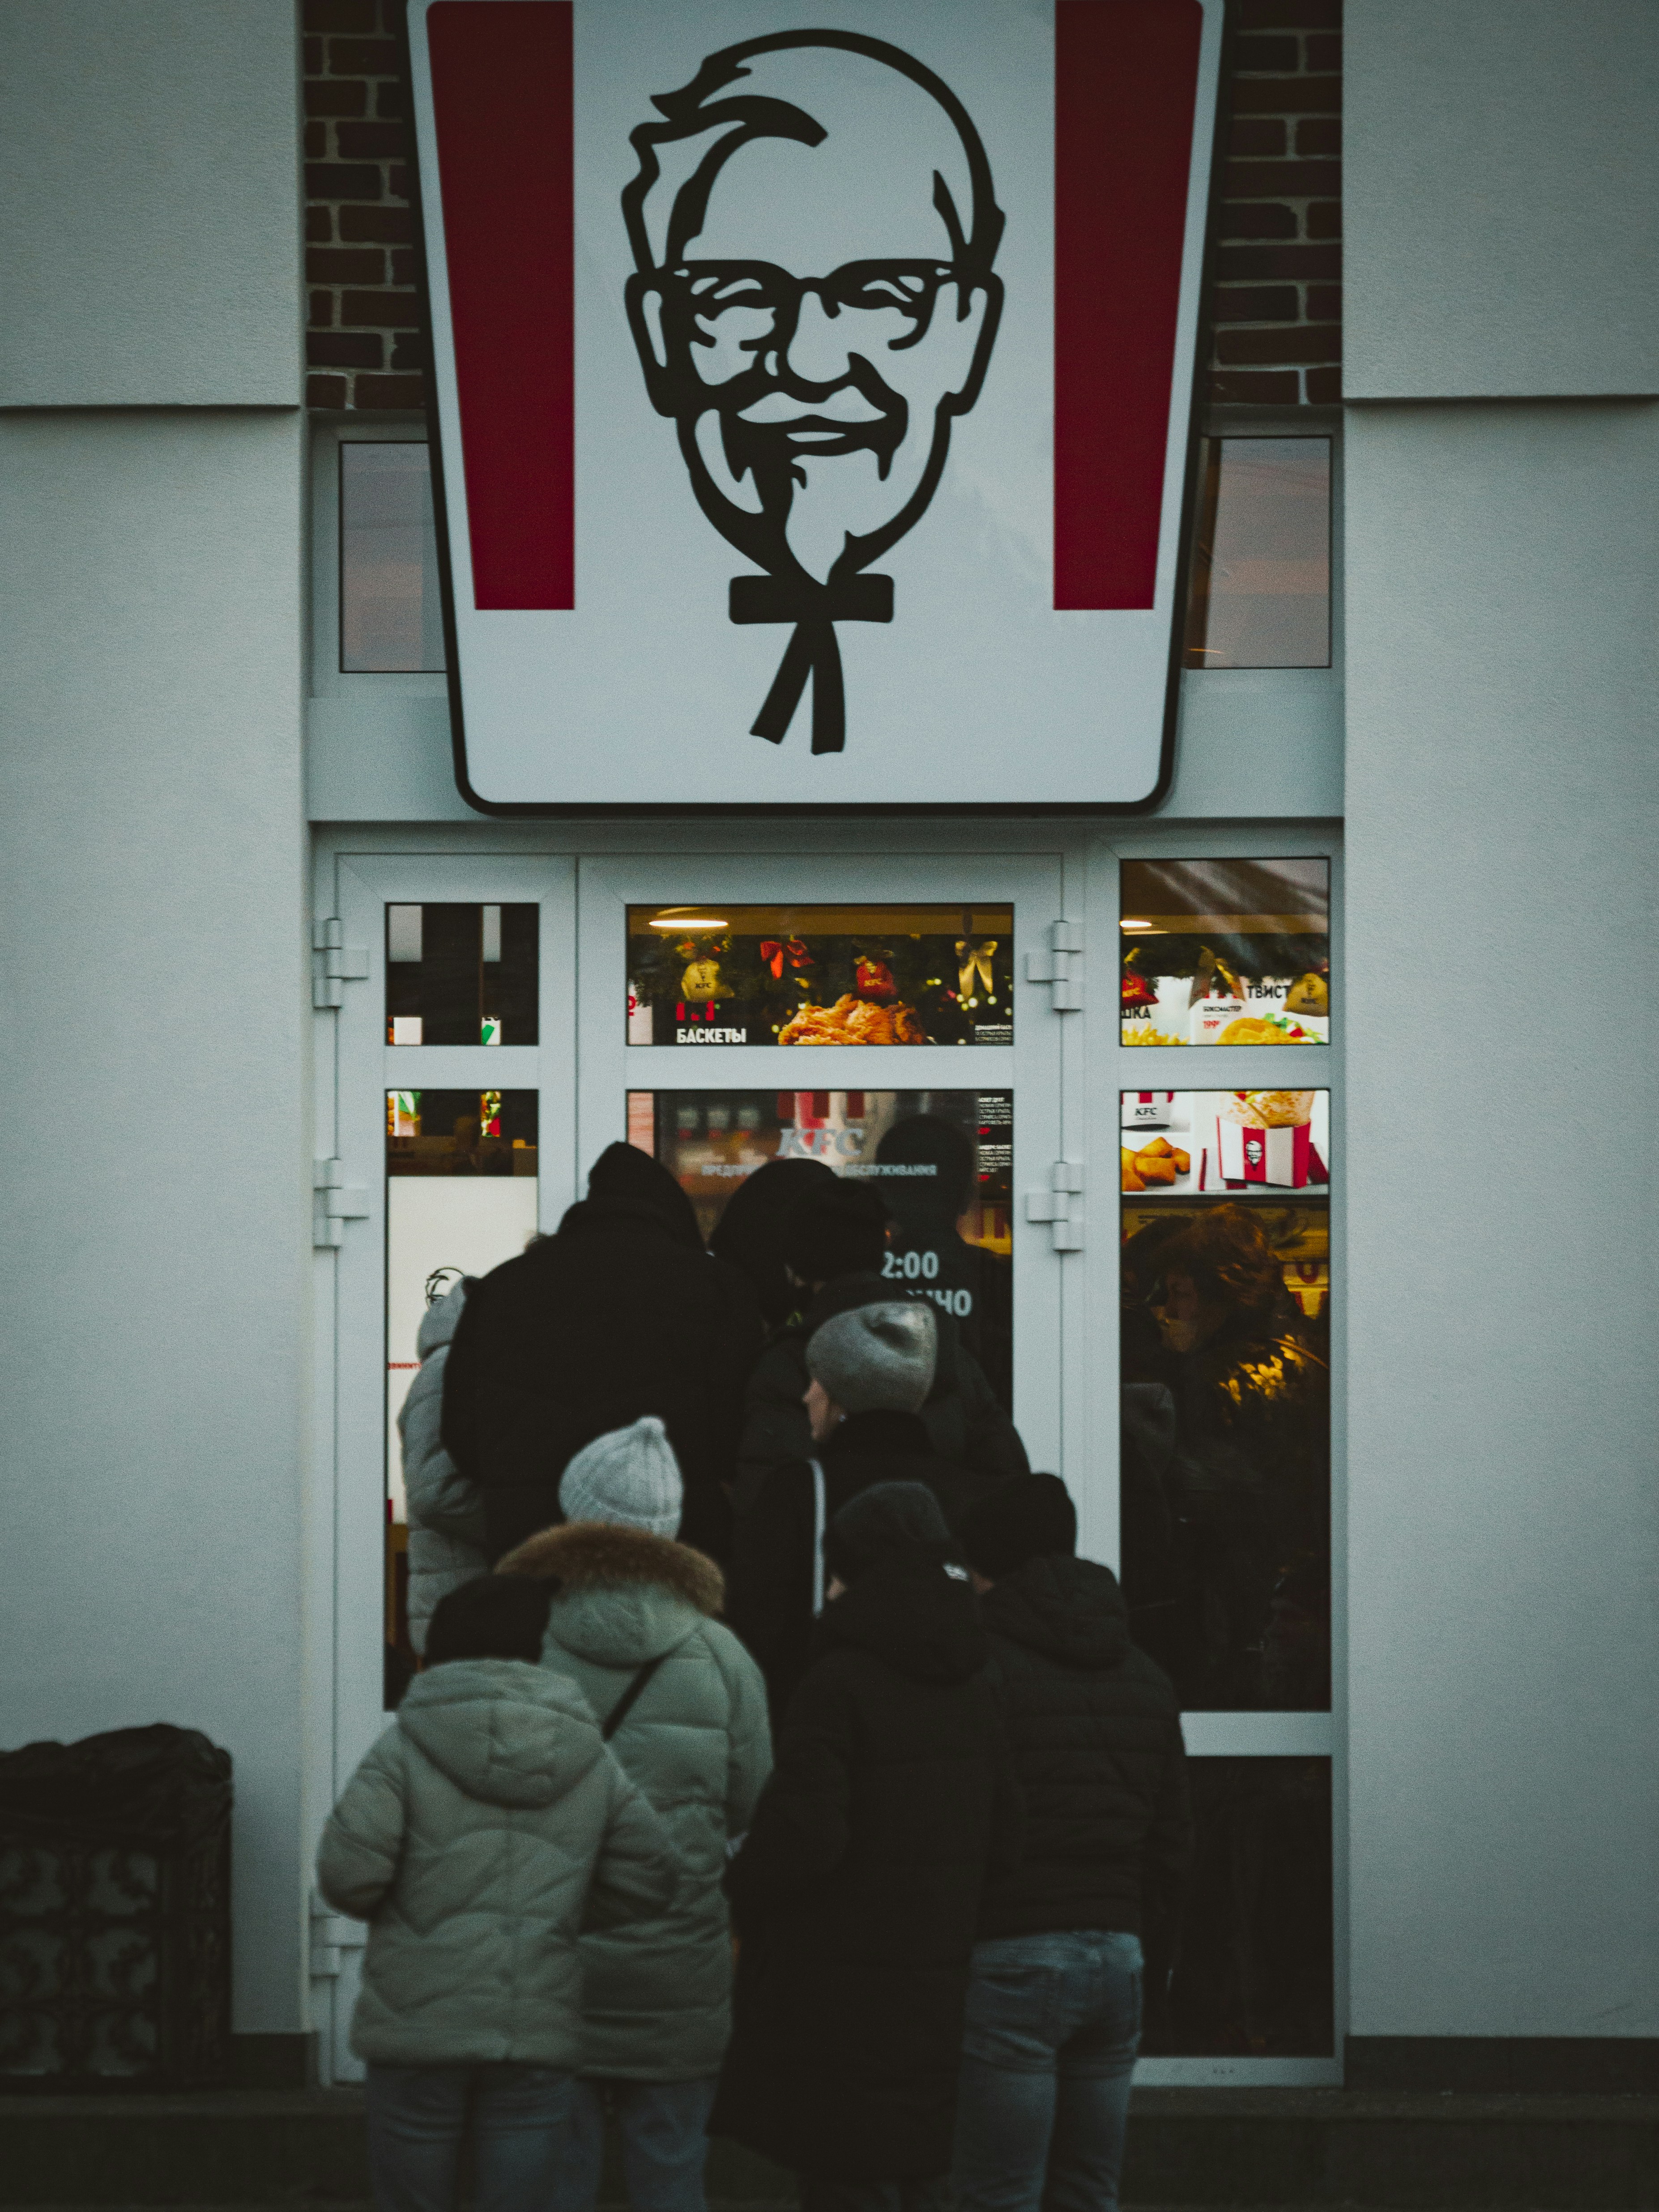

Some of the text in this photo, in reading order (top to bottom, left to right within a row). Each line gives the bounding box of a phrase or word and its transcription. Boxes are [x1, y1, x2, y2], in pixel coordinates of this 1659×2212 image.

[677, 1028, 746, 1043] БАСКЕТЫ
[1135, 1107, 1157, 1116] KFC
[776, 1128, 863, 1156] KFC
